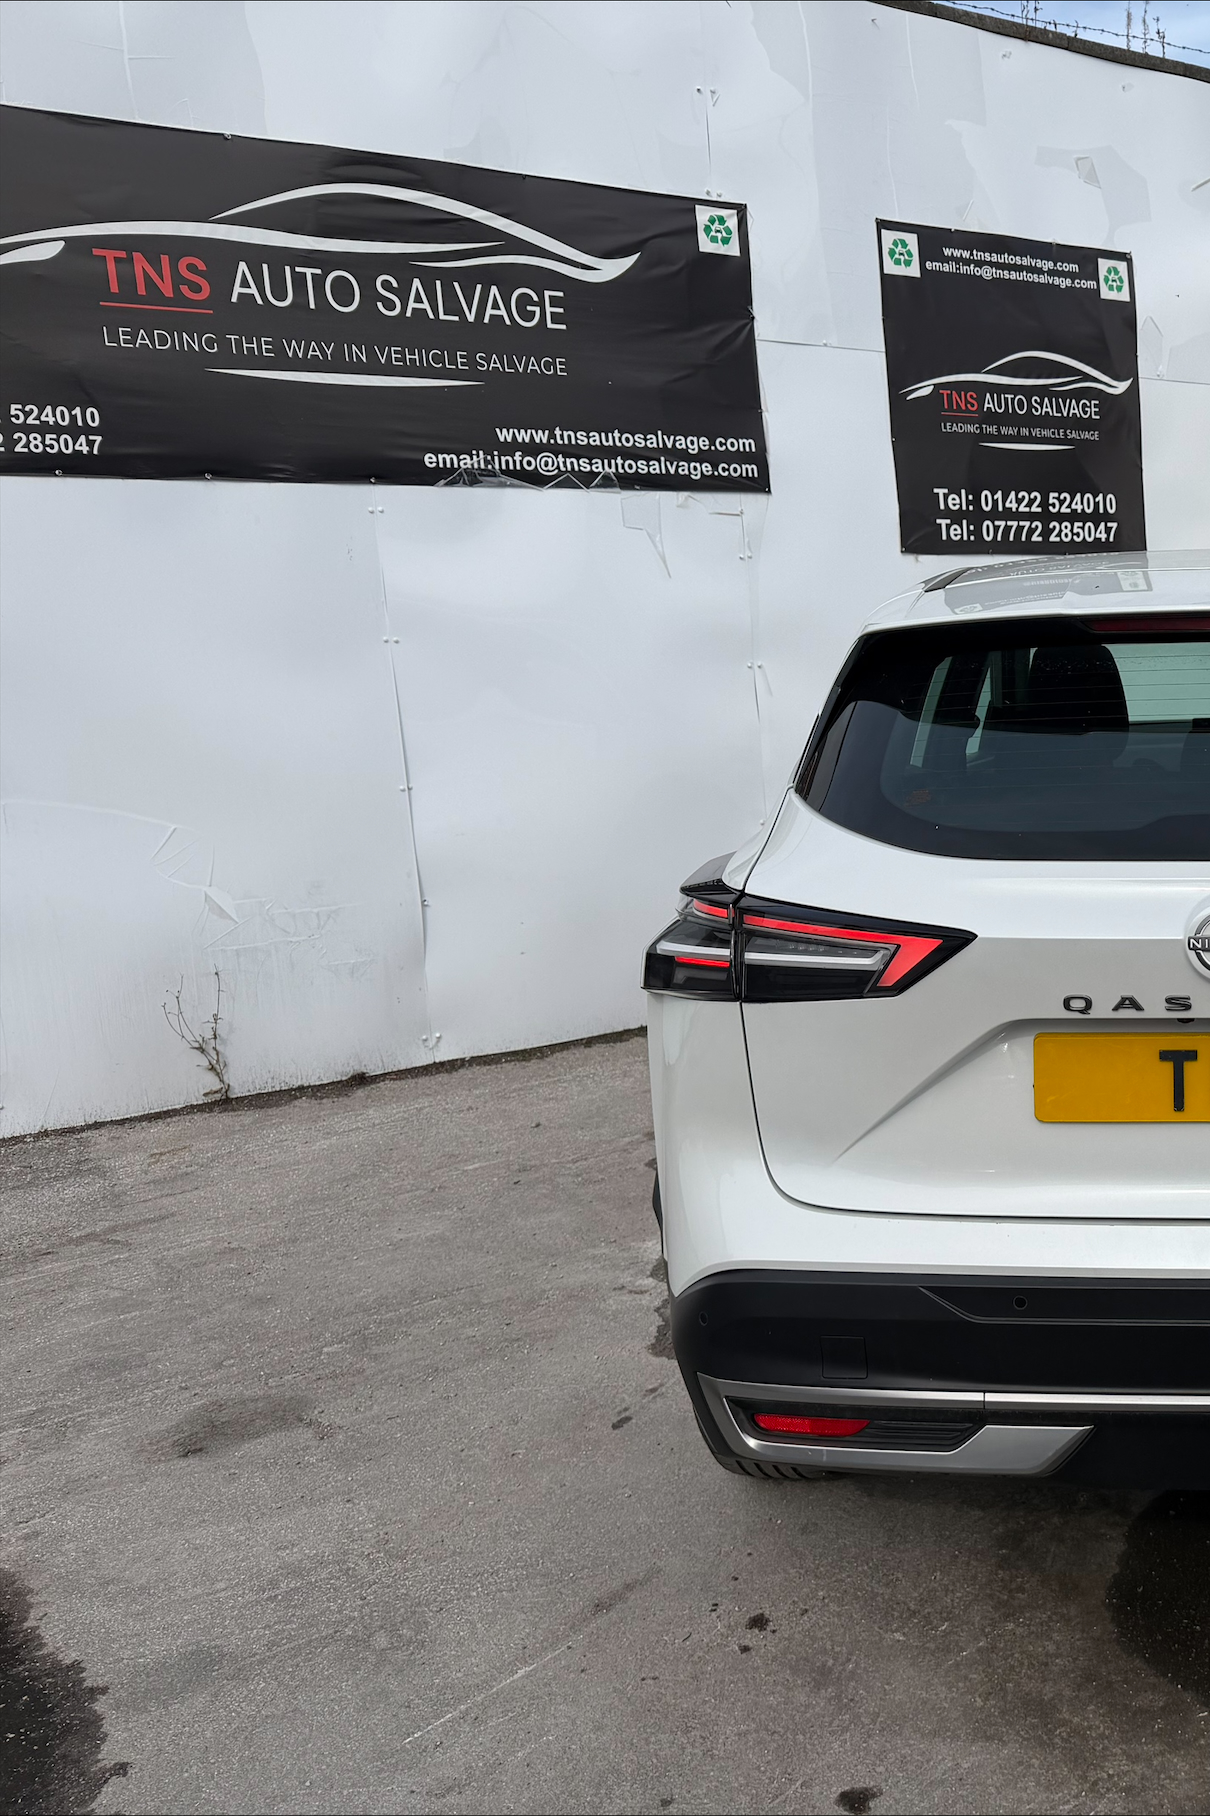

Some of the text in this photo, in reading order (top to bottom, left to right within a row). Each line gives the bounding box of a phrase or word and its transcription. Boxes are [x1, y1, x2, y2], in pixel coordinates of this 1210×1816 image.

[943, 247, 1079, 272] www.tnsautosalvage.com
[926, 260, 1097, 289] email:info@tnsautosalvage.com
[92, 248, 567, 330] TNS AUTO SALVAGE
[102, 326, 567, 376] LEADING THE WAY IN VEHICLE SALVAGE
[9, 403, 100, 428] 524010
[940, 390, 1100, 419] TNS AUTO SALVAGE
[12, 431, 103, 455] 285047
[495, 426, 756, 453] www.tnsautosalvage.com
[941, 422, 1100, 441] LEADING THE WAY IN VEHICLE SALVAGE
[424, 449, 758, 479] email:info@tnsautosalvage.com
[933, 488, 1117, 515] Tel: 01422 524010
[936, 519, 1118, 542] Tel: 07772 285047
